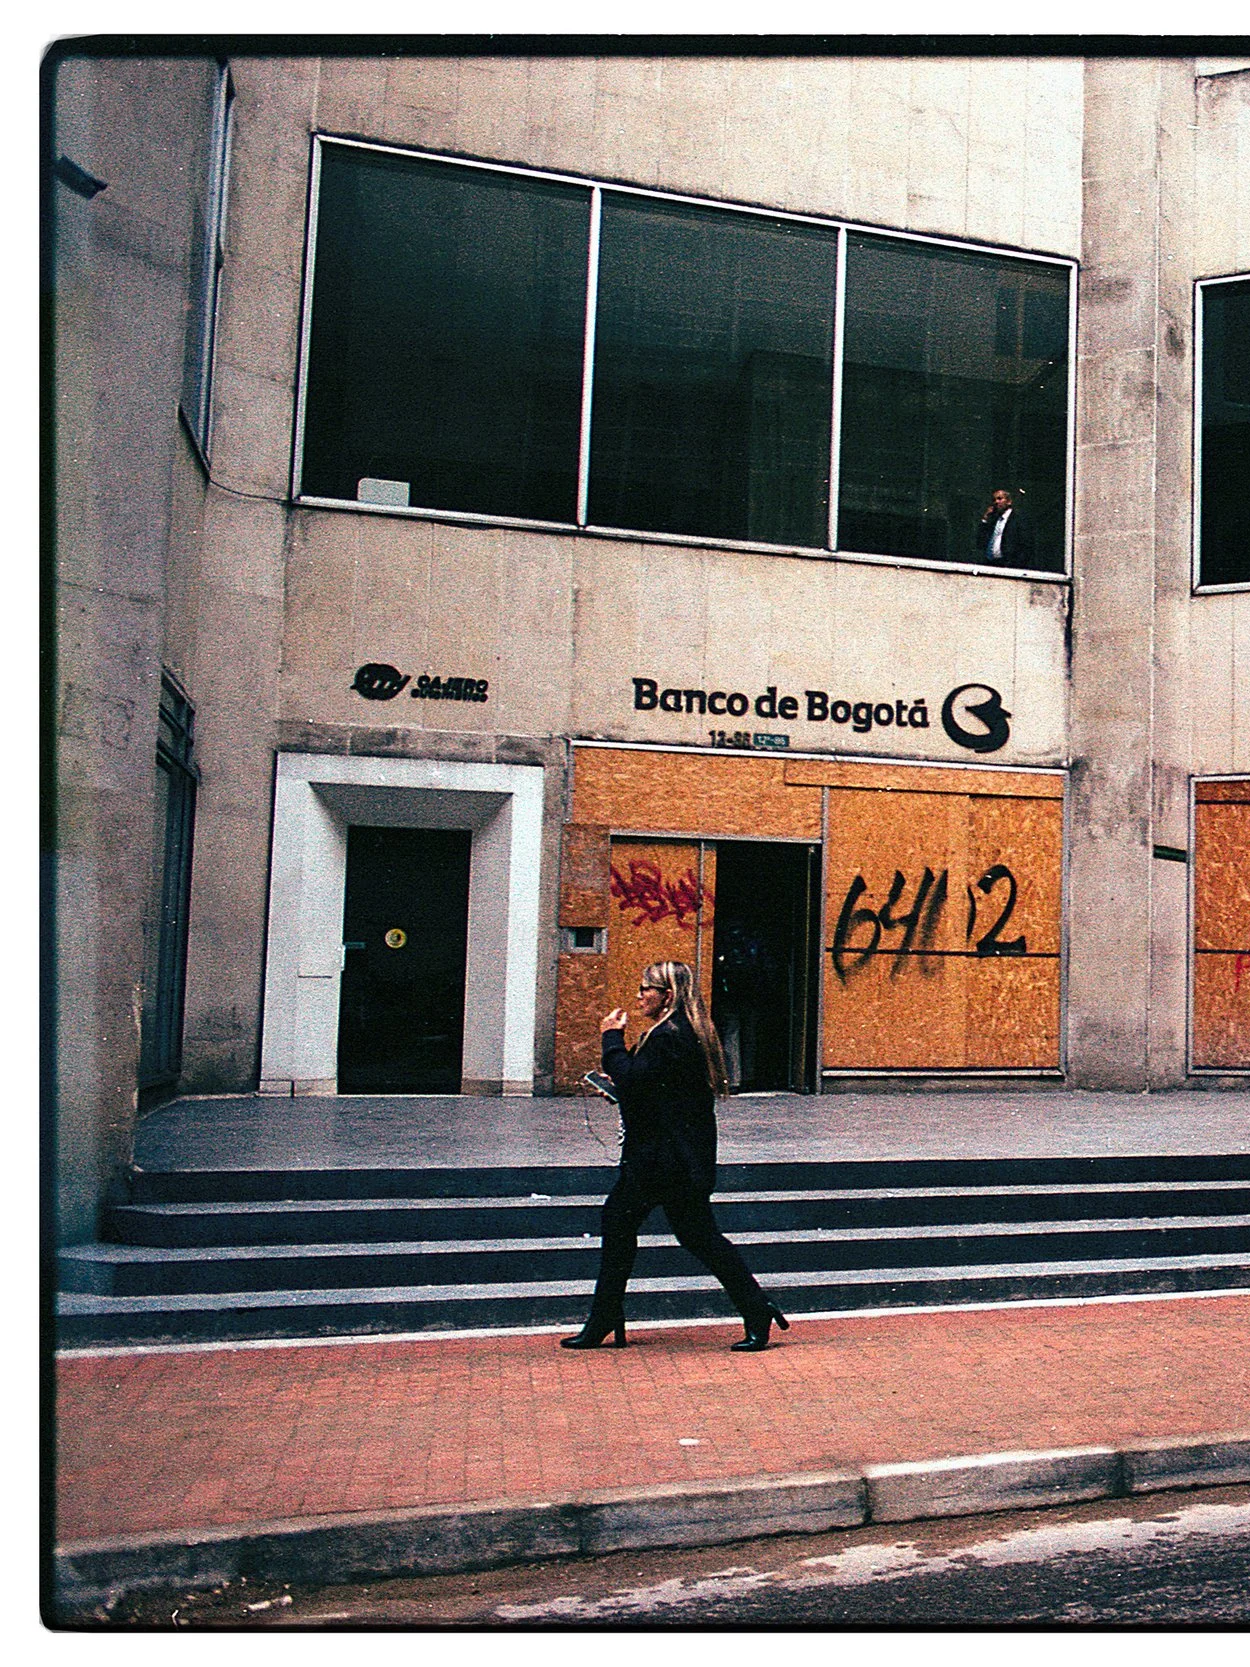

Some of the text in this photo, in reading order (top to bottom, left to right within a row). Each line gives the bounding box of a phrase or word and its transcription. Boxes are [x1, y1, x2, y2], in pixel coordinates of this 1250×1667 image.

[632, 677, 930, 733] Banco de Bogotá
